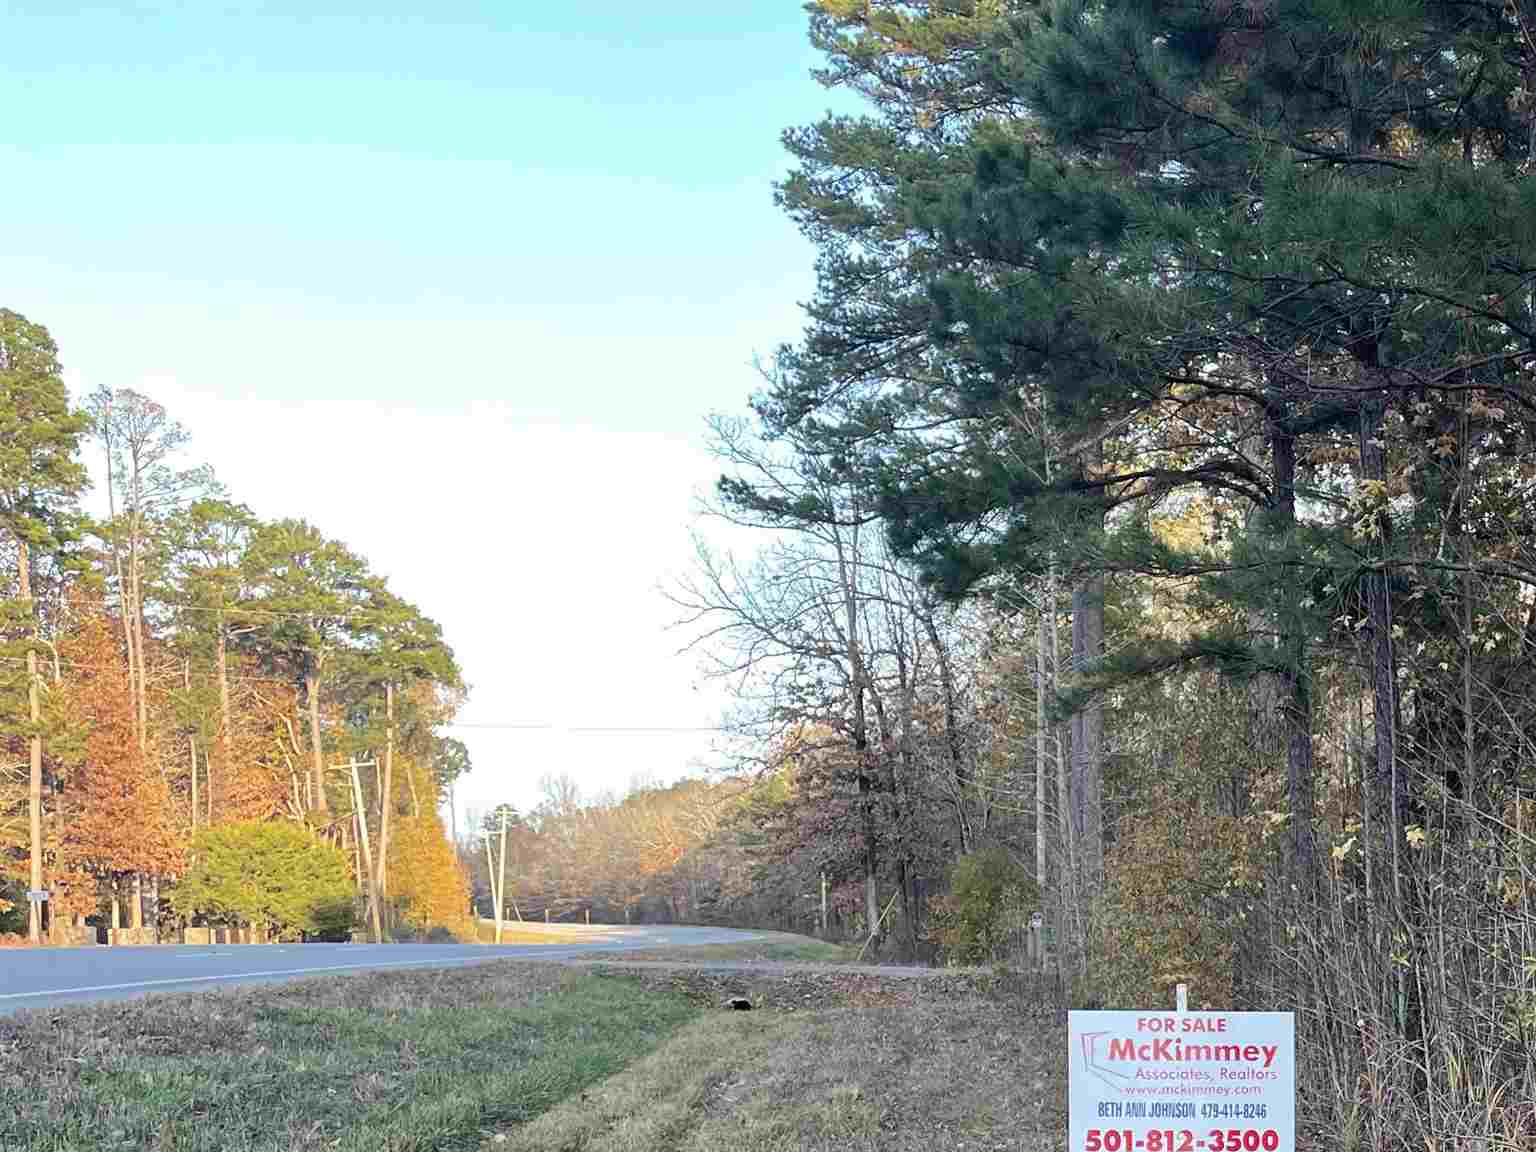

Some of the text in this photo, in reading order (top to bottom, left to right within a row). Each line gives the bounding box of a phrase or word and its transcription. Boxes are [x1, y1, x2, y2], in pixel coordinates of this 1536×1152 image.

[1137, 1018, 1226, 1032] FOR SALE
[1107, 1038, 1277, 1067] McKimmey
[1135, 1068, 1278, 1081] Associates, Realtors
[1124, 1084, 1262, 1097] www.mckimmey.com
[1098, 1102, 1267, 1119] BETH ANN JOHNSON 479-414-8246
[1085, 1129, 1279, 1152] 501-812-3500
